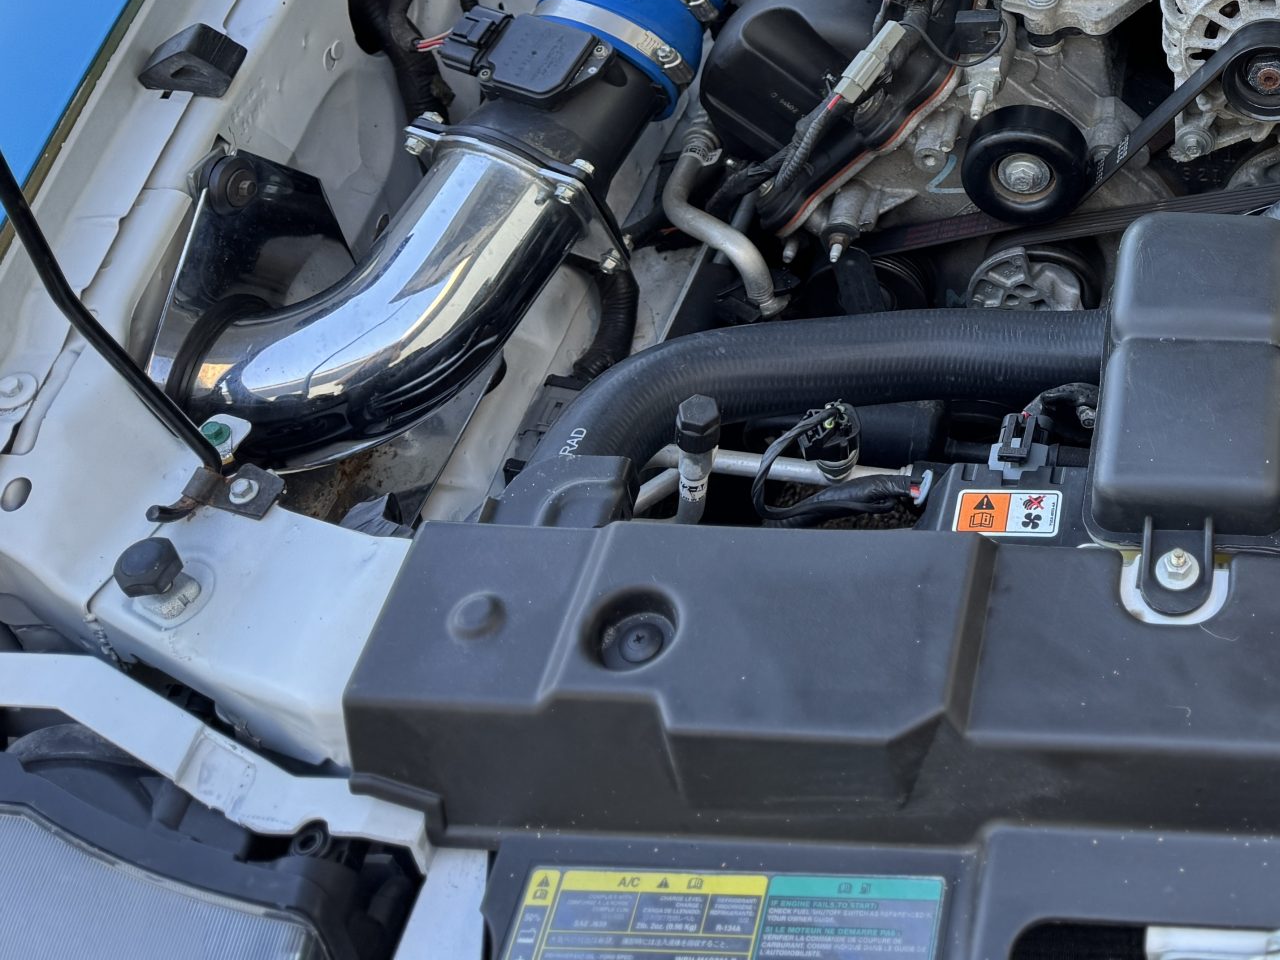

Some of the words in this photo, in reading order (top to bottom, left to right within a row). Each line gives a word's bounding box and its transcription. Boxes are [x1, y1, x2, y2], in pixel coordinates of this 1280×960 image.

[559, 427, 587, 456] RAD
[617, 877, 641, 888] A/C
[780, 900, 811, 908] ENGINE
